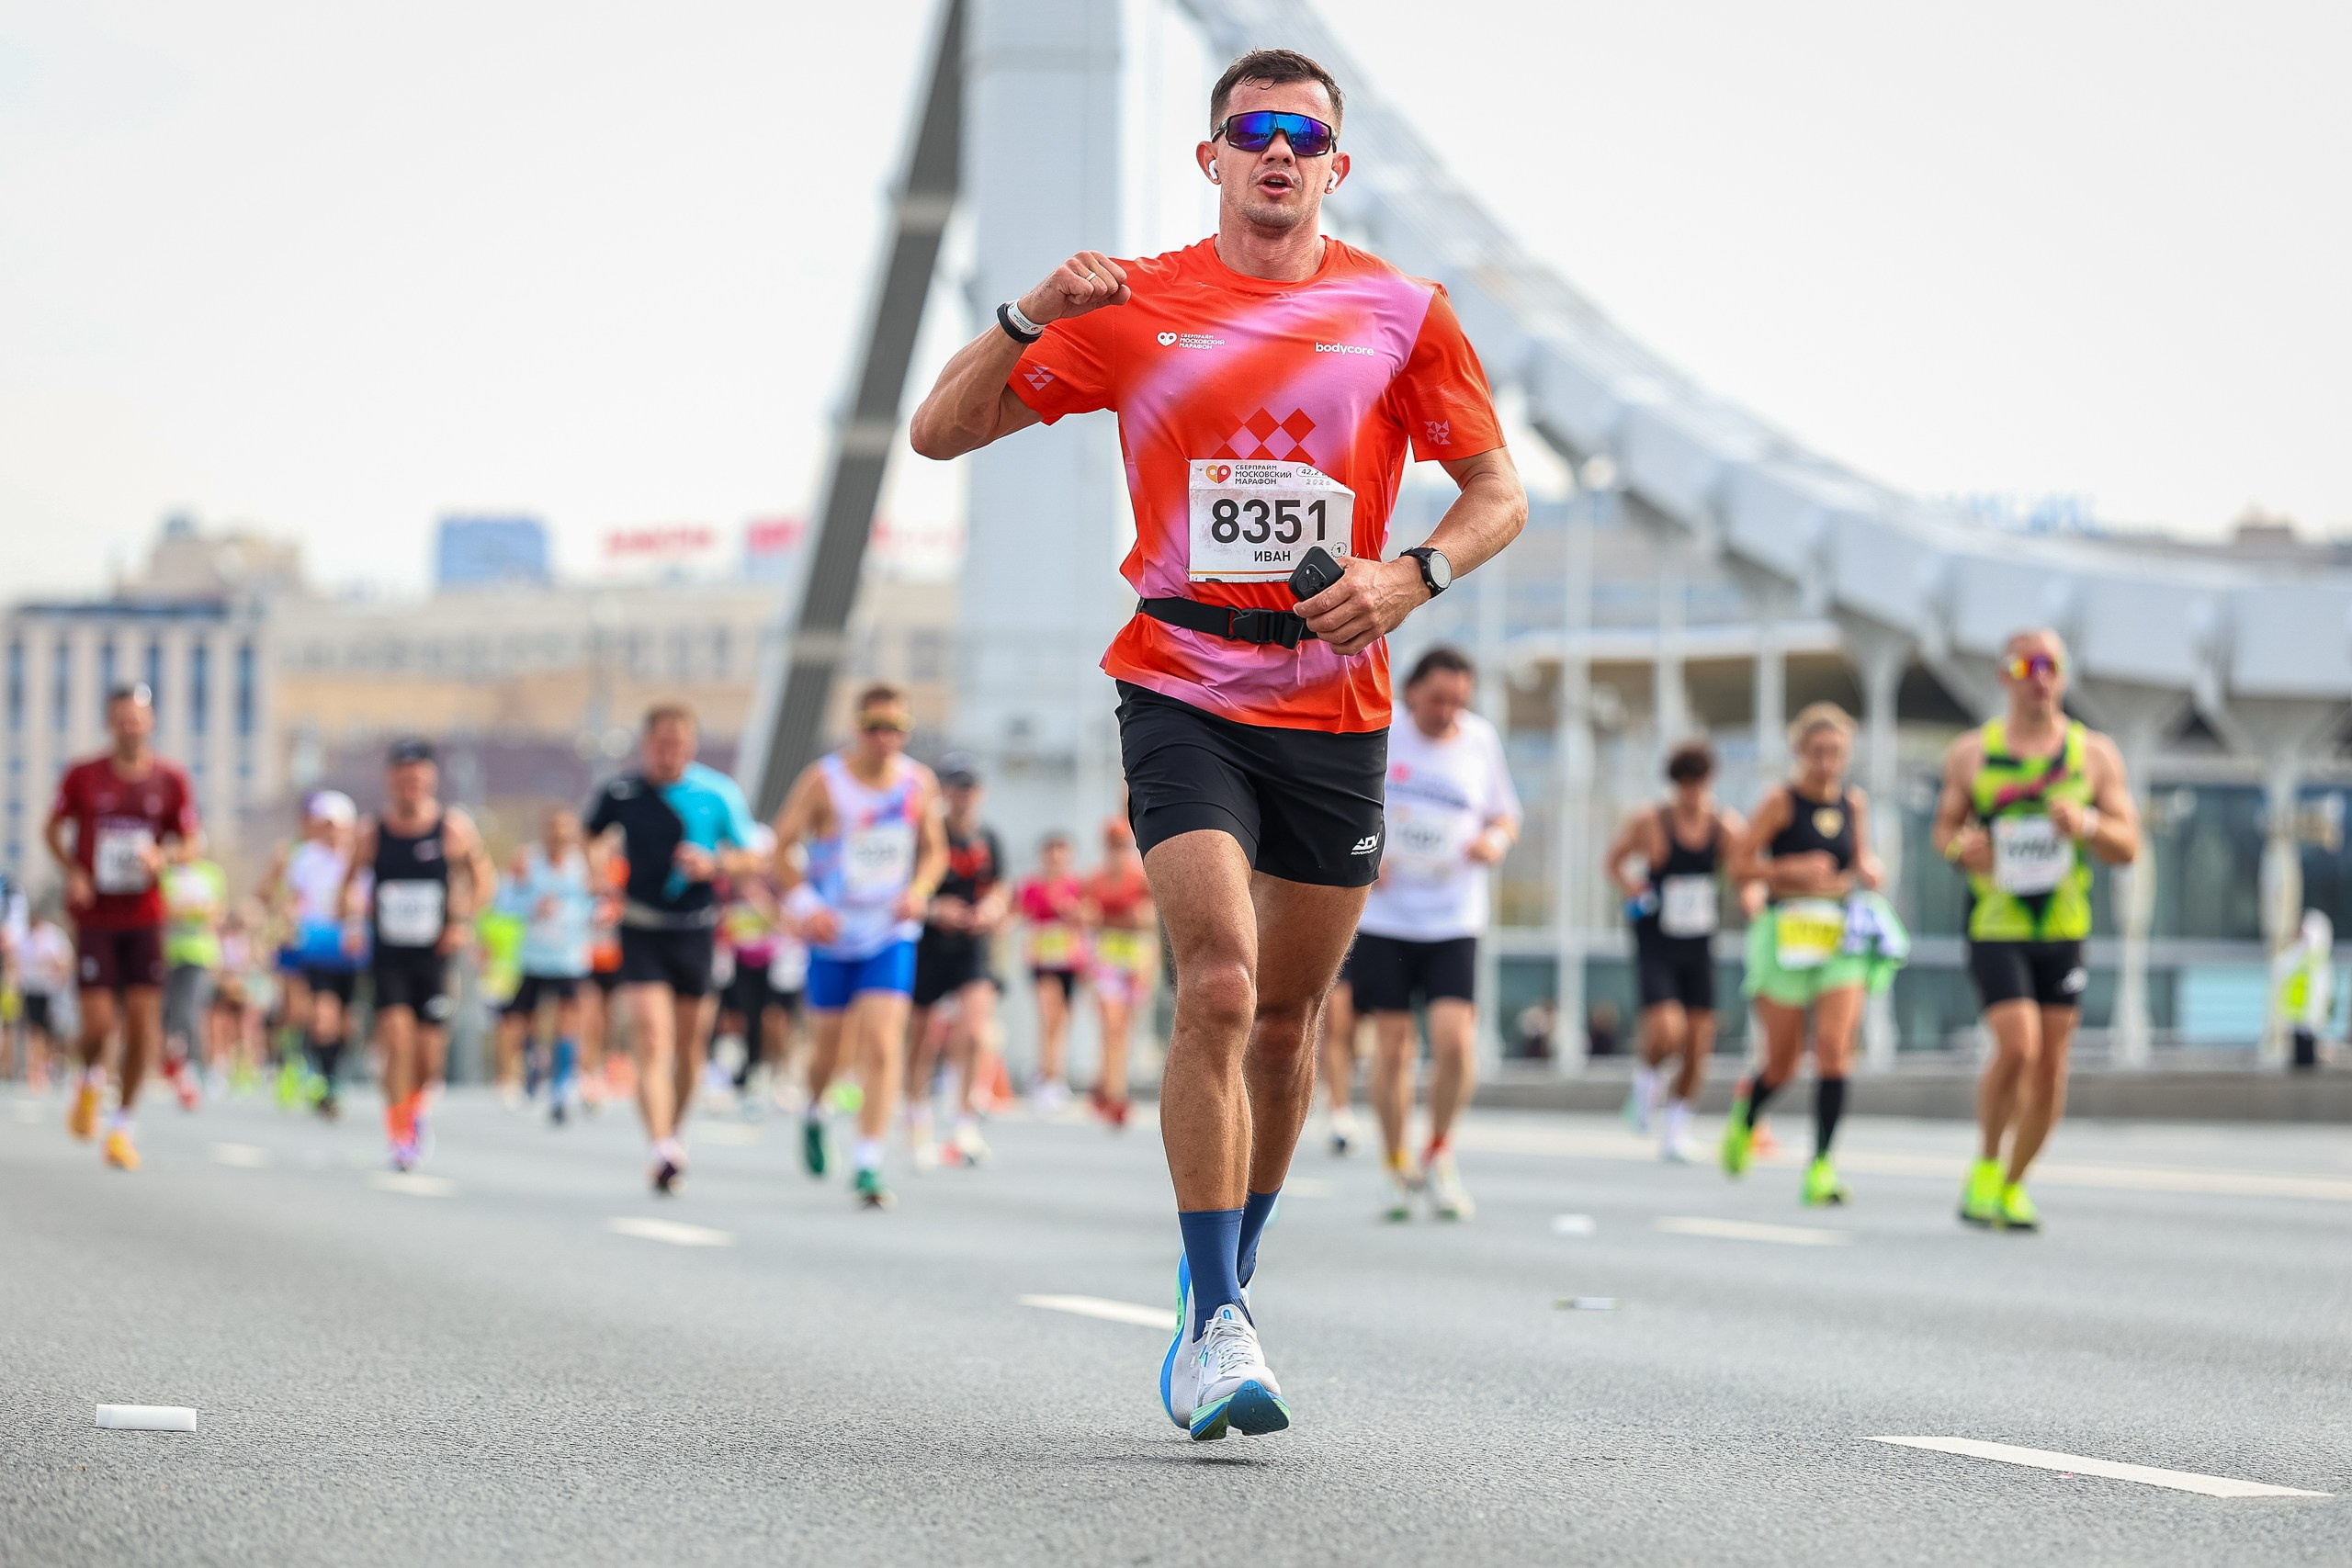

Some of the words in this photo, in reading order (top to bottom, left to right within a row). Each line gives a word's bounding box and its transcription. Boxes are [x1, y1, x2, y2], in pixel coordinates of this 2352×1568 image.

[1315, 342, 1374, 356] bodycore
[1211, 498, 1326, 544] 8351
[1253, 550, 1291, 562] ИВАН
